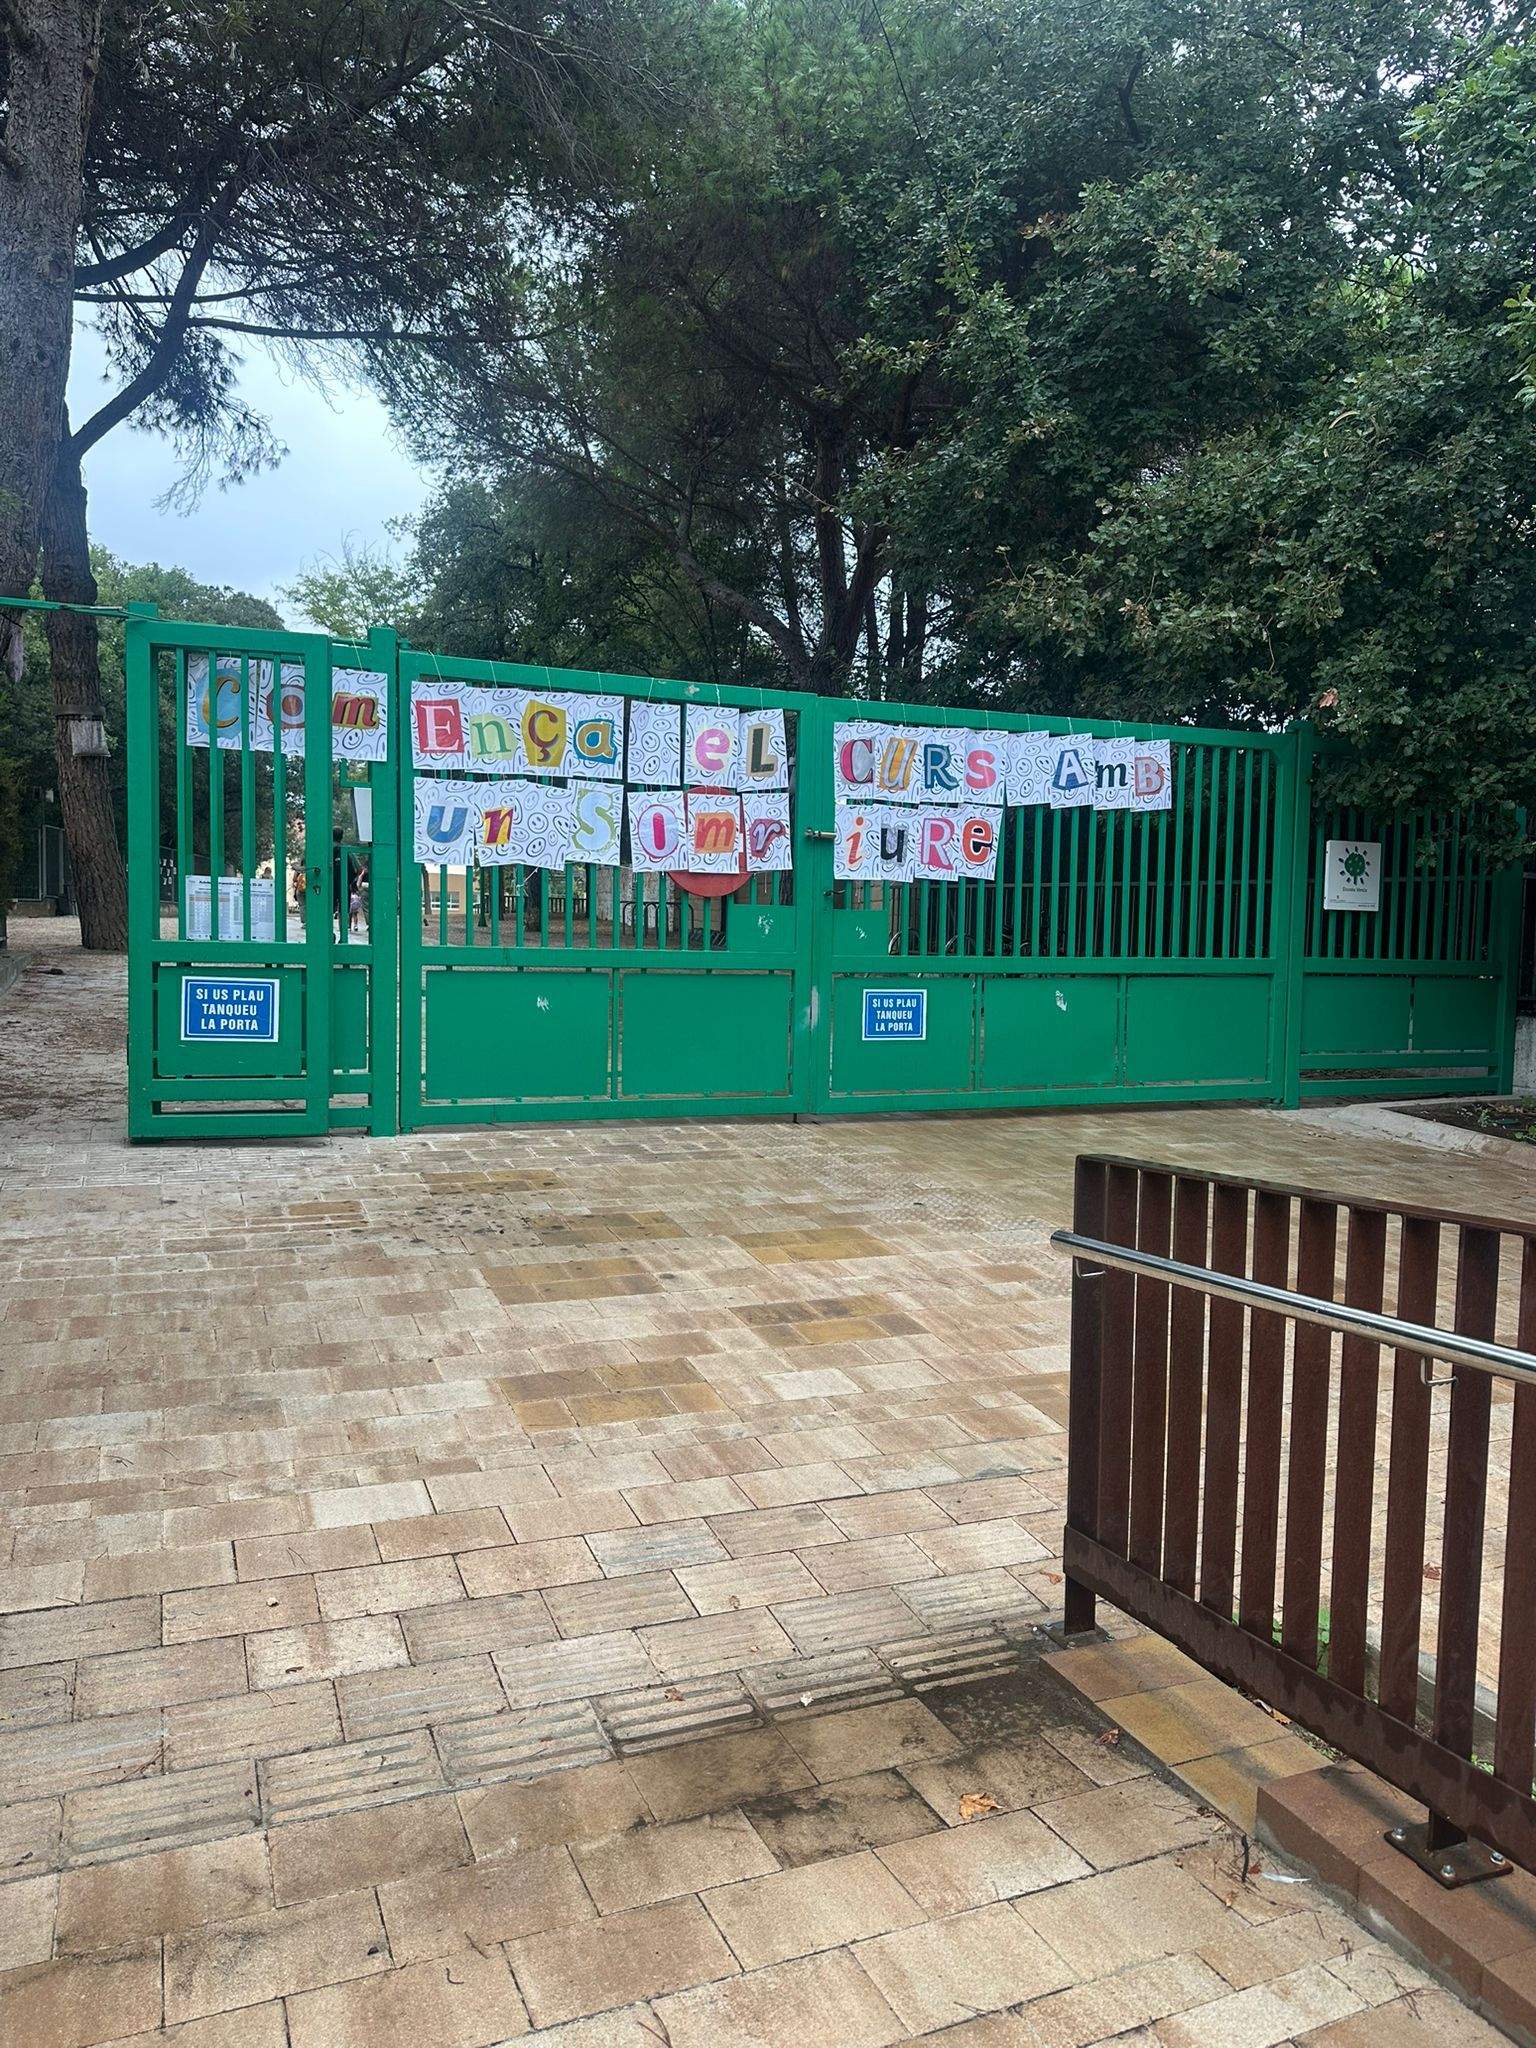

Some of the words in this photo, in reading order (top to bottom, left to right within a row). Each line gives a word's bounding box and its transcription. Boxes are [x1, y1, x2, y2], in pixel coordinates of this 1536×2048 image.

[426, 804, 517, 846] un
[196, 988, 208, 1000] SI
[212, 989, 228, 1000] US
[233, 990, 264, 1001] PLAU
[202, 1003, 257, 1016] TANQUEU
[872, 999, 881, 1008] SI
[883, 999, 894, 1008] US
[896, 999, 917, 1008] PLAU
[877, 1011, 912, 1020] TANQUEU
[201, 1018, 216, 1030] LA
[220, 1019, 258, 1031] PORTA
[876, 1022, 885, 1031] LA
[888, 1022, 913, 1031] PORTA
